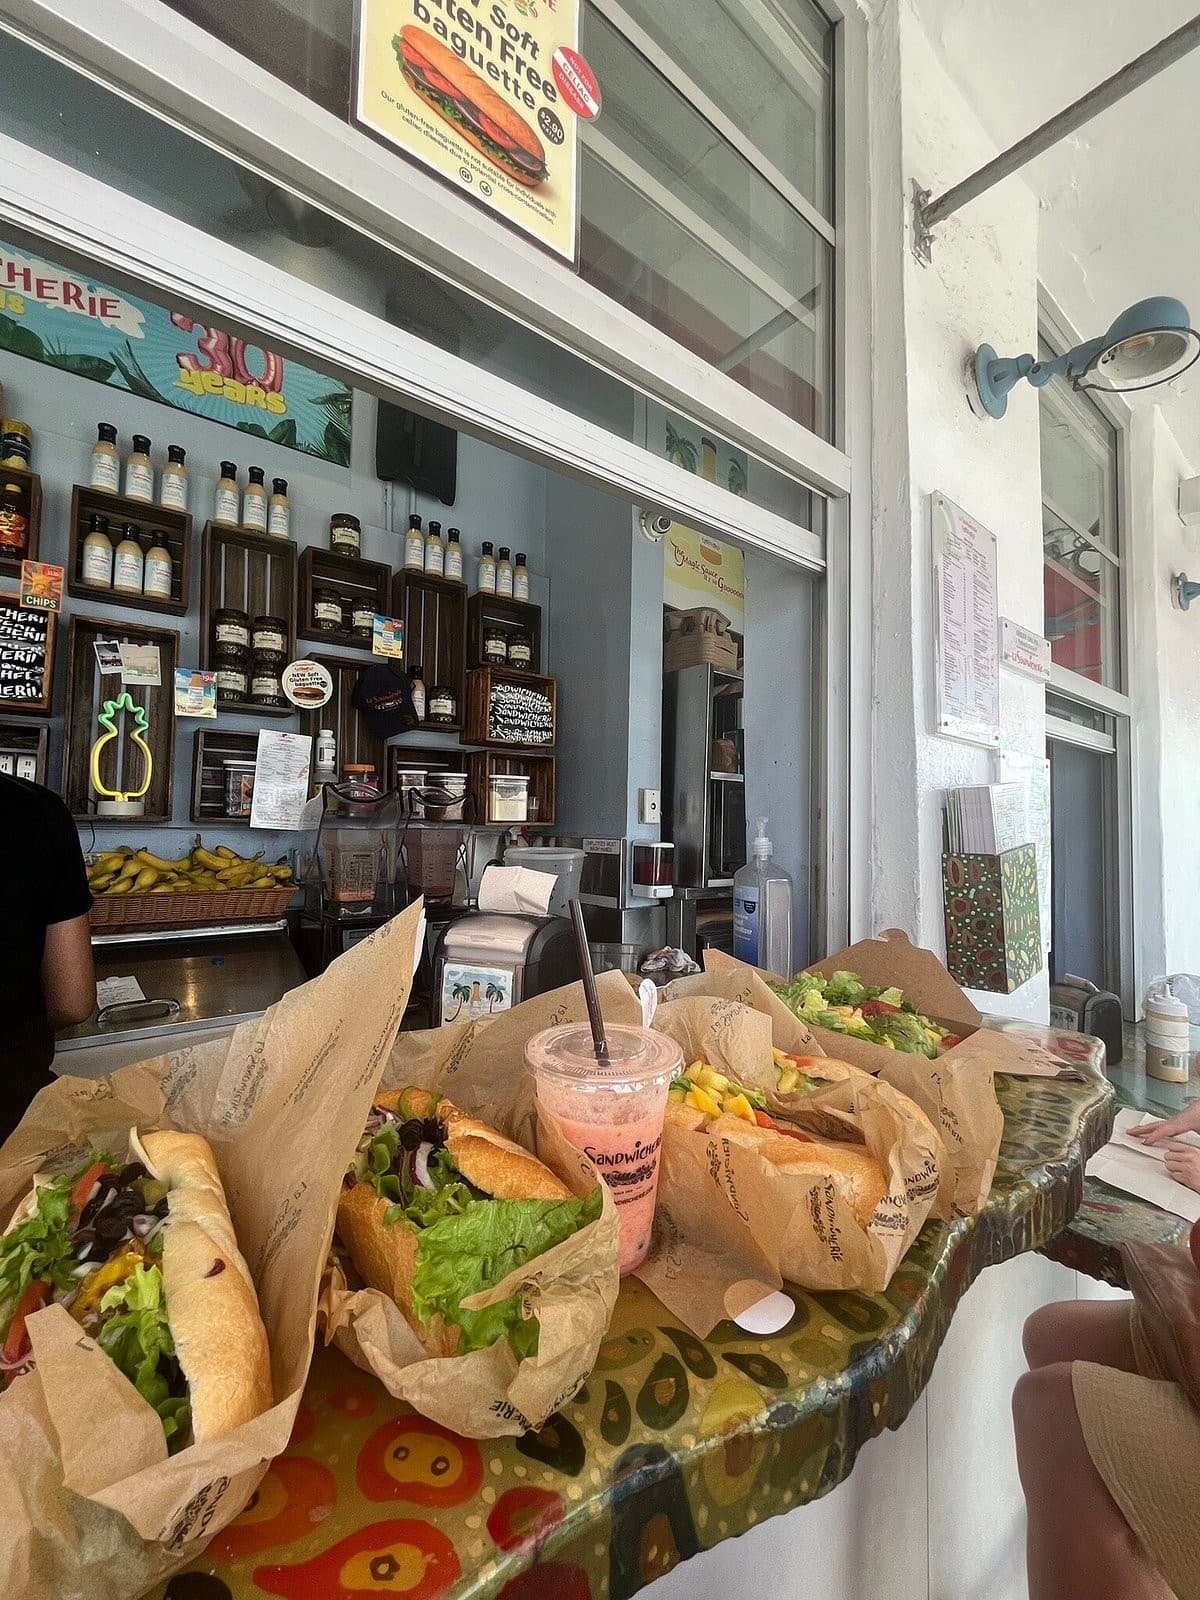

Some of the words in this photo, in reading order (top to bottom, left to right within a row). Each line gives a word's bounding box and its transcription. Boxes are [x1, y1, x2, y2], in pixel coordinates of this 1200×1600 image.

[490, 4, 540, 60] Soft
[413, 0, 536, 110] baguette
[500, 37, 557, 103] Free
[562, 62, 590, 103] CELIAC
[381, 90, 395, 103] Our
[396, 102, 434, 132] gluten-free
[540, 111, 563, 139] $2.90
[26, 595, 56, 609] CHIPS
